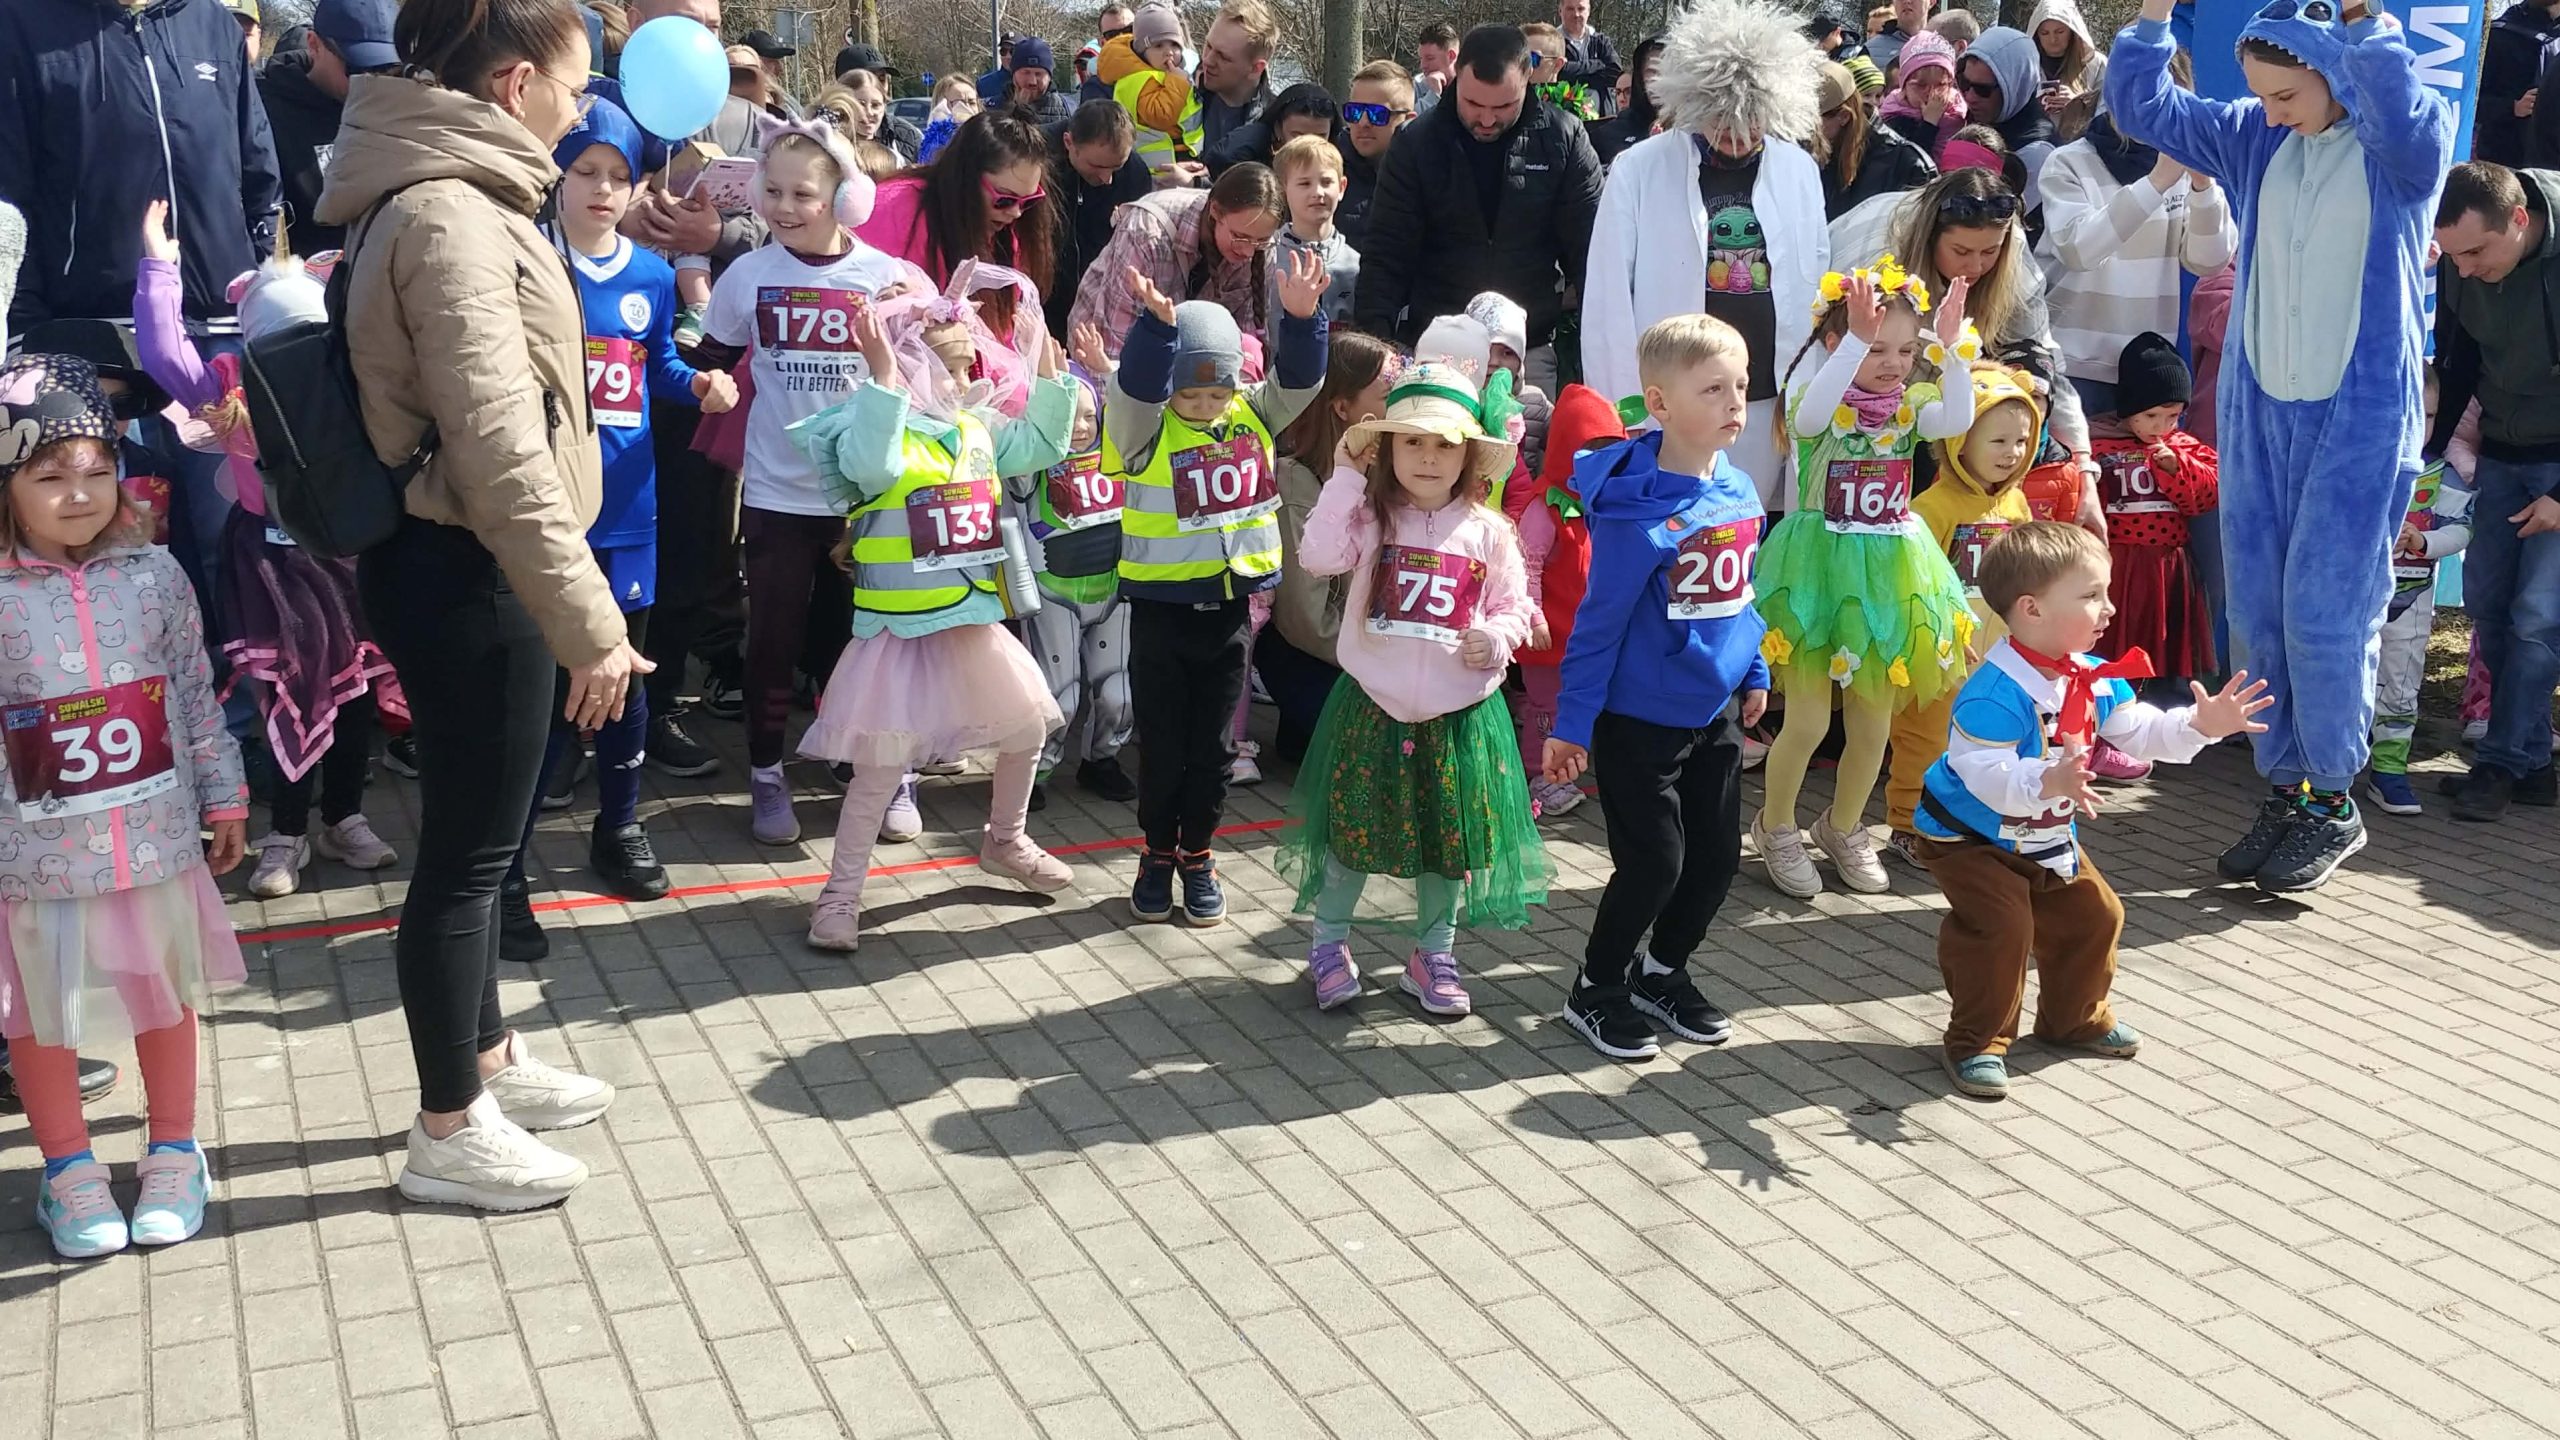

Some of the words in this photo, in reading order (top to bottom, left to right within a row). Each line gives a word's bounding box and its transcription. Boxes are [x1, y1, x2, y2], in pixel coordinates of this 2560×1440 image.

[772, 306, 849, 344] 178
[787, 376, 805, 391] FLY
[808, 377, 849, 392] BETTER
[1073, 472, 1114, 508] 10
[1188, 457, 1258, 507] 107
[1840, 481, 1905, 518] 164
[2113, 466, 2167, 497] 10
[927, 502, 994, 547] 133
[1397, 570, 1458, 617] 75
[58, 696, 106, 714] SUWALSKI
[51, 718, 142, 782] 39
